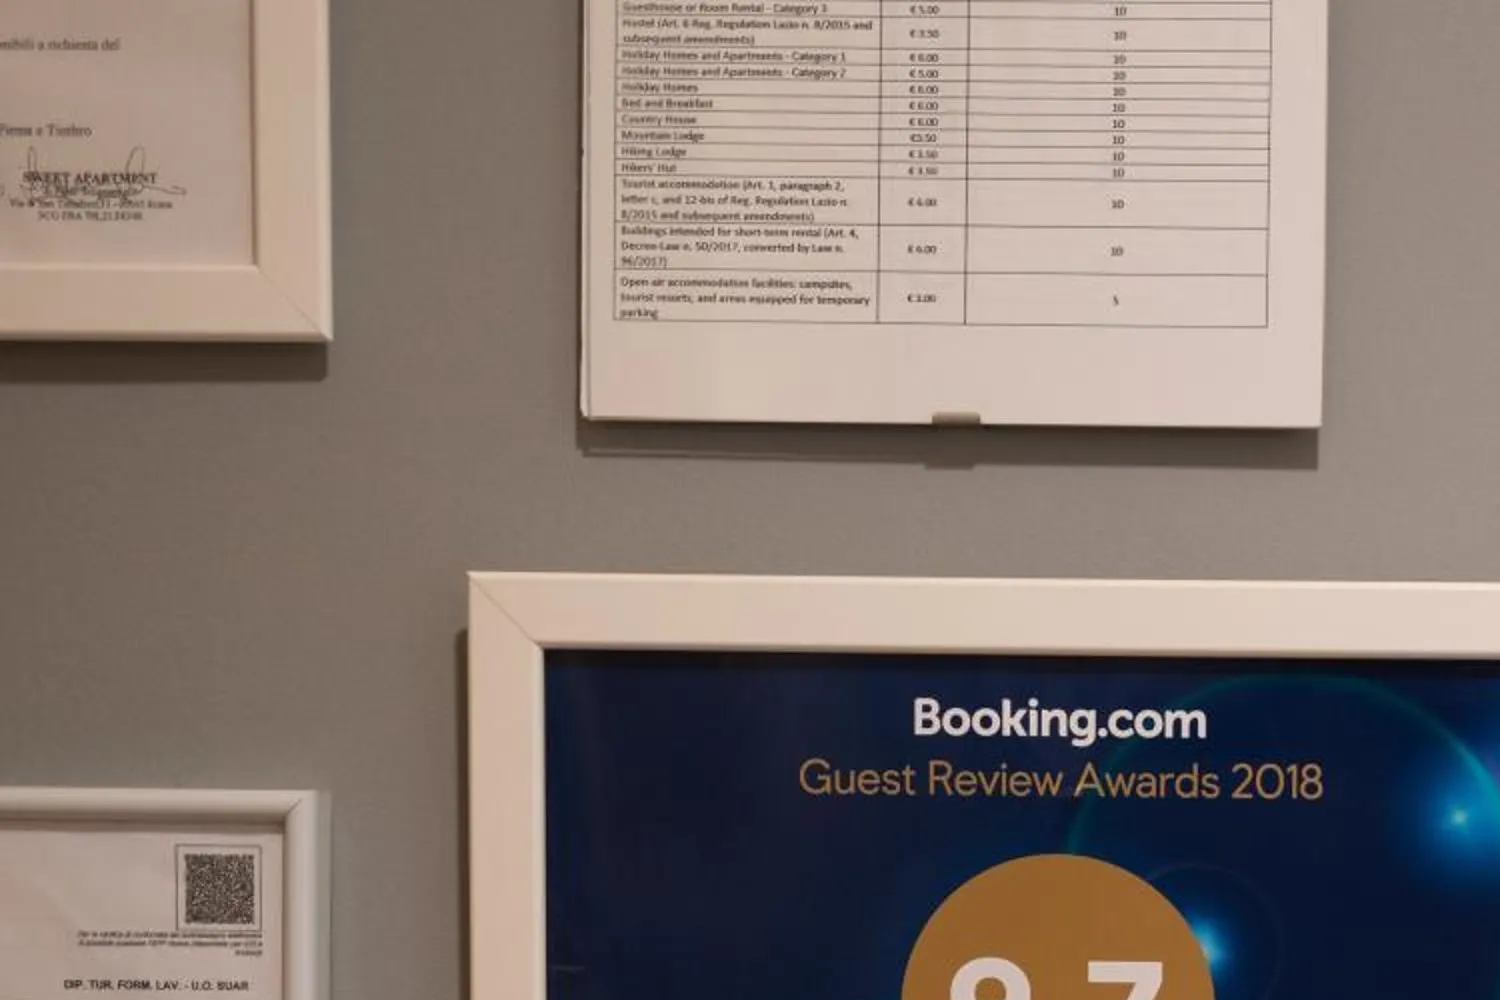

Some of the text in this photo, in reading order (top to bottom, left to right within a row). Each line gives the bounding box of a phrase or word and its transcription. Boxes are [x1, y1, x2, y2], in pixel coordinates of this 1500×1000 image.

[913, 697, 1207, 747] Booking.com
[799, 758, 1323, 800] Guest Review Awards 2018
